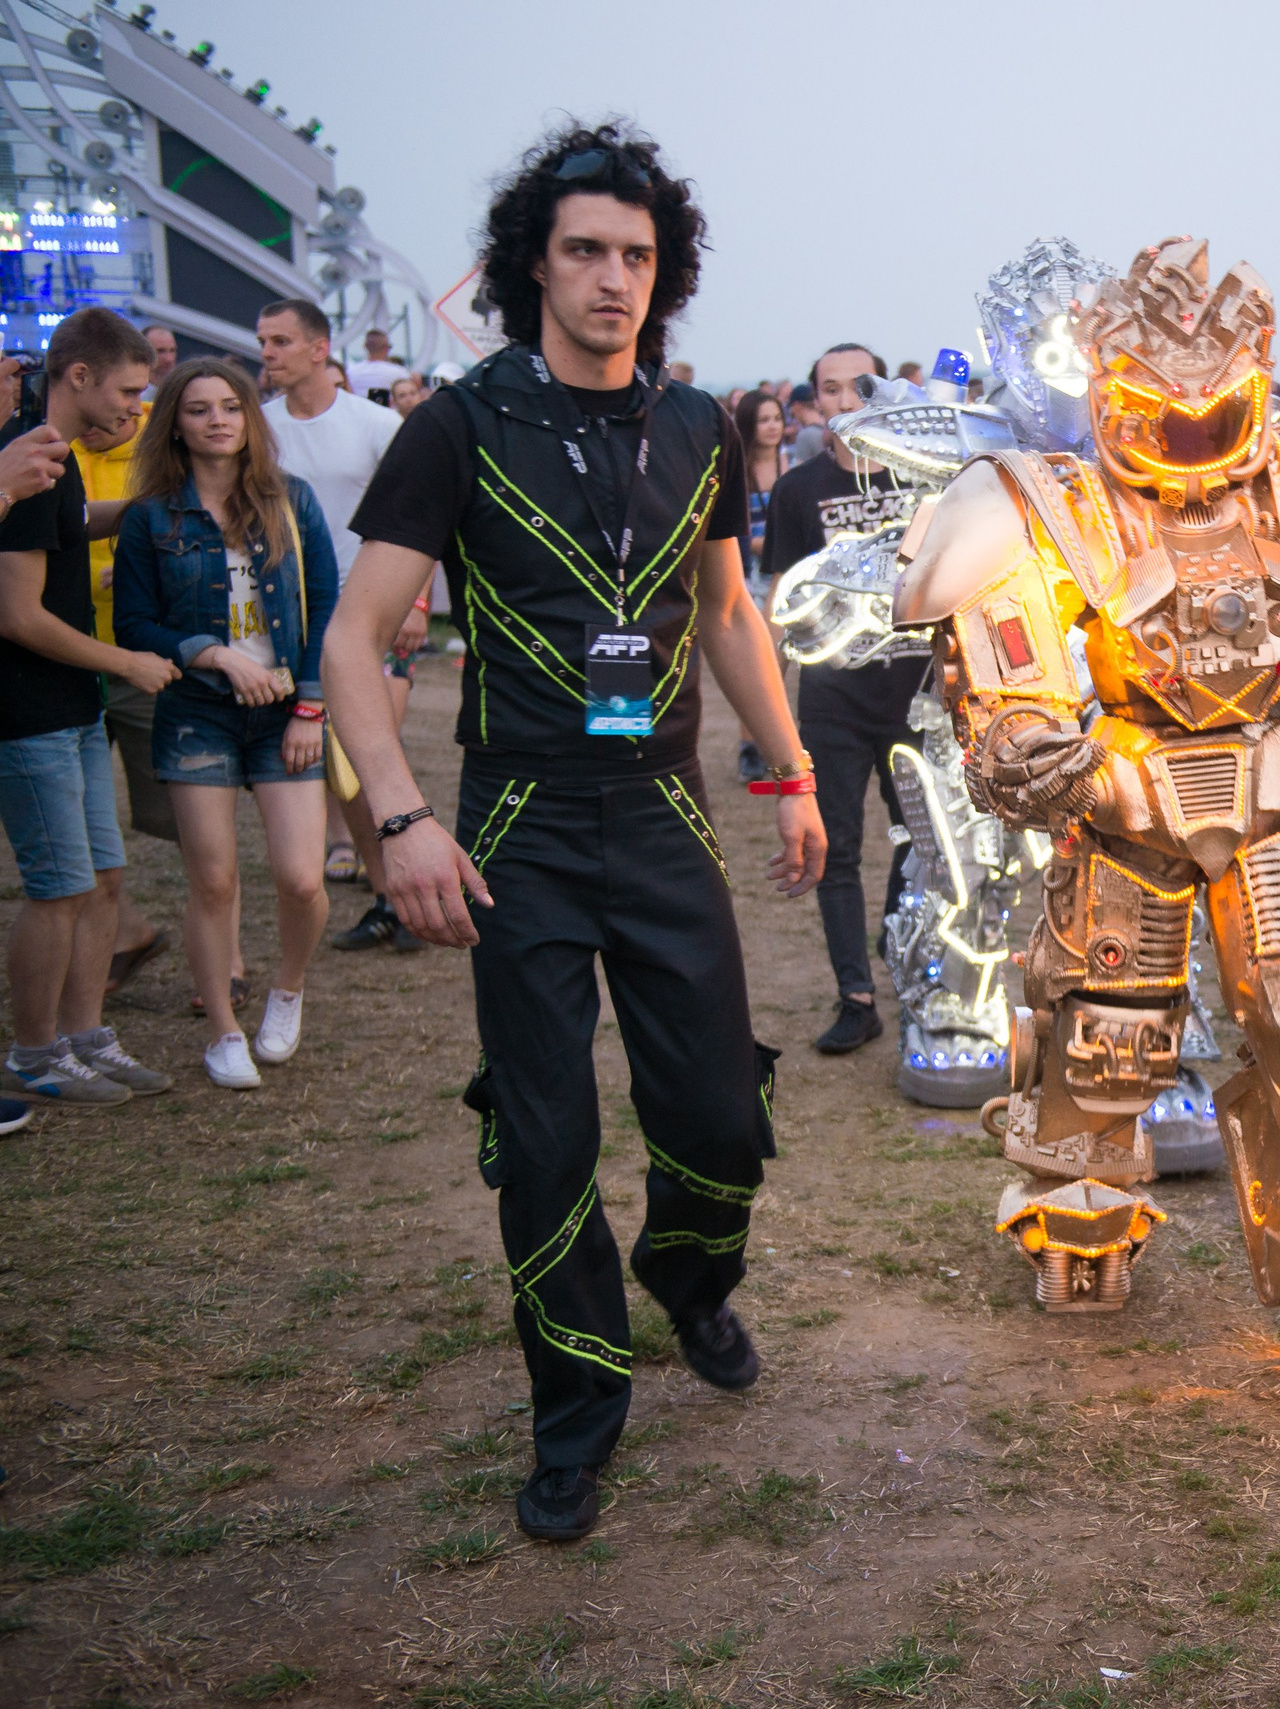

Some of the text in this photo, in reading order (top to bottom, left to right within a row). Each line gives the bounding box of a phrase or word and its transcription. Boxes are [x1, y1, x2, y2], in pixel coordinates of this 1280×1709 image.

[562, 439, 589, 474] AFP
[227, 565, 259, 593] T'S
[588, 633, 651, 657] AFP
